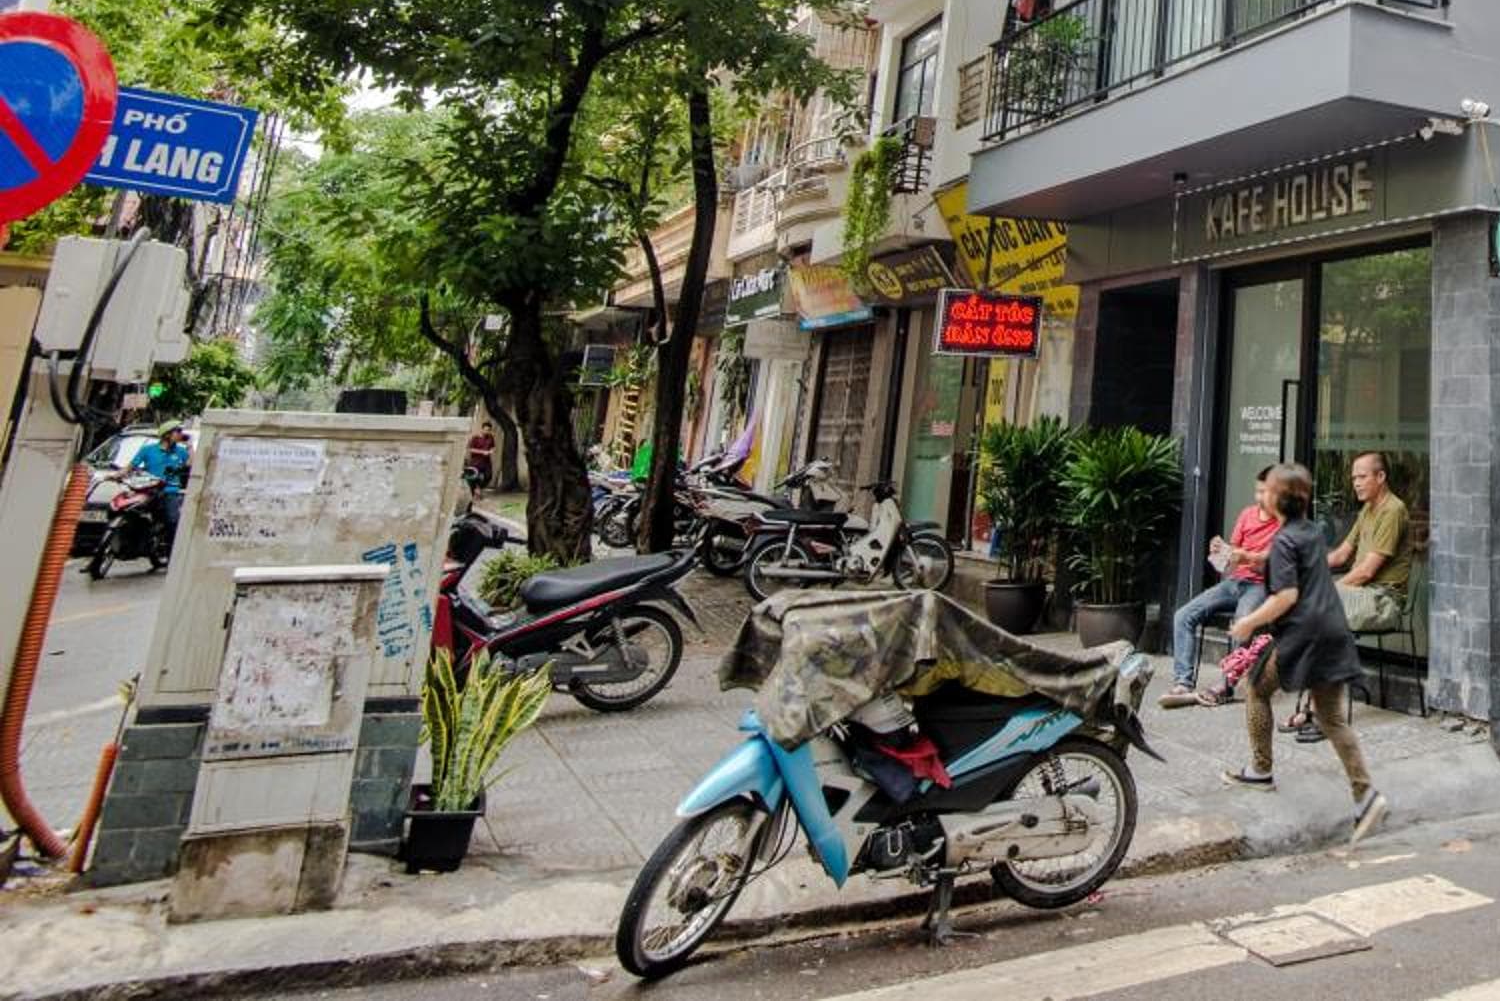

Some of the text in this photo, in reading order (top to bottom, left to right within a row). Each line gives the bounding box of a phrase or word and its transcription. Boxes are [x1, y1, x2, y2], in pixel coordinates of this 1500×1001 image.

[123, 109, 192, 134] PHỐ
[123, 138, 224, 184] LANG
[1206, 160, 1376, 241] KAFE HOUSE
